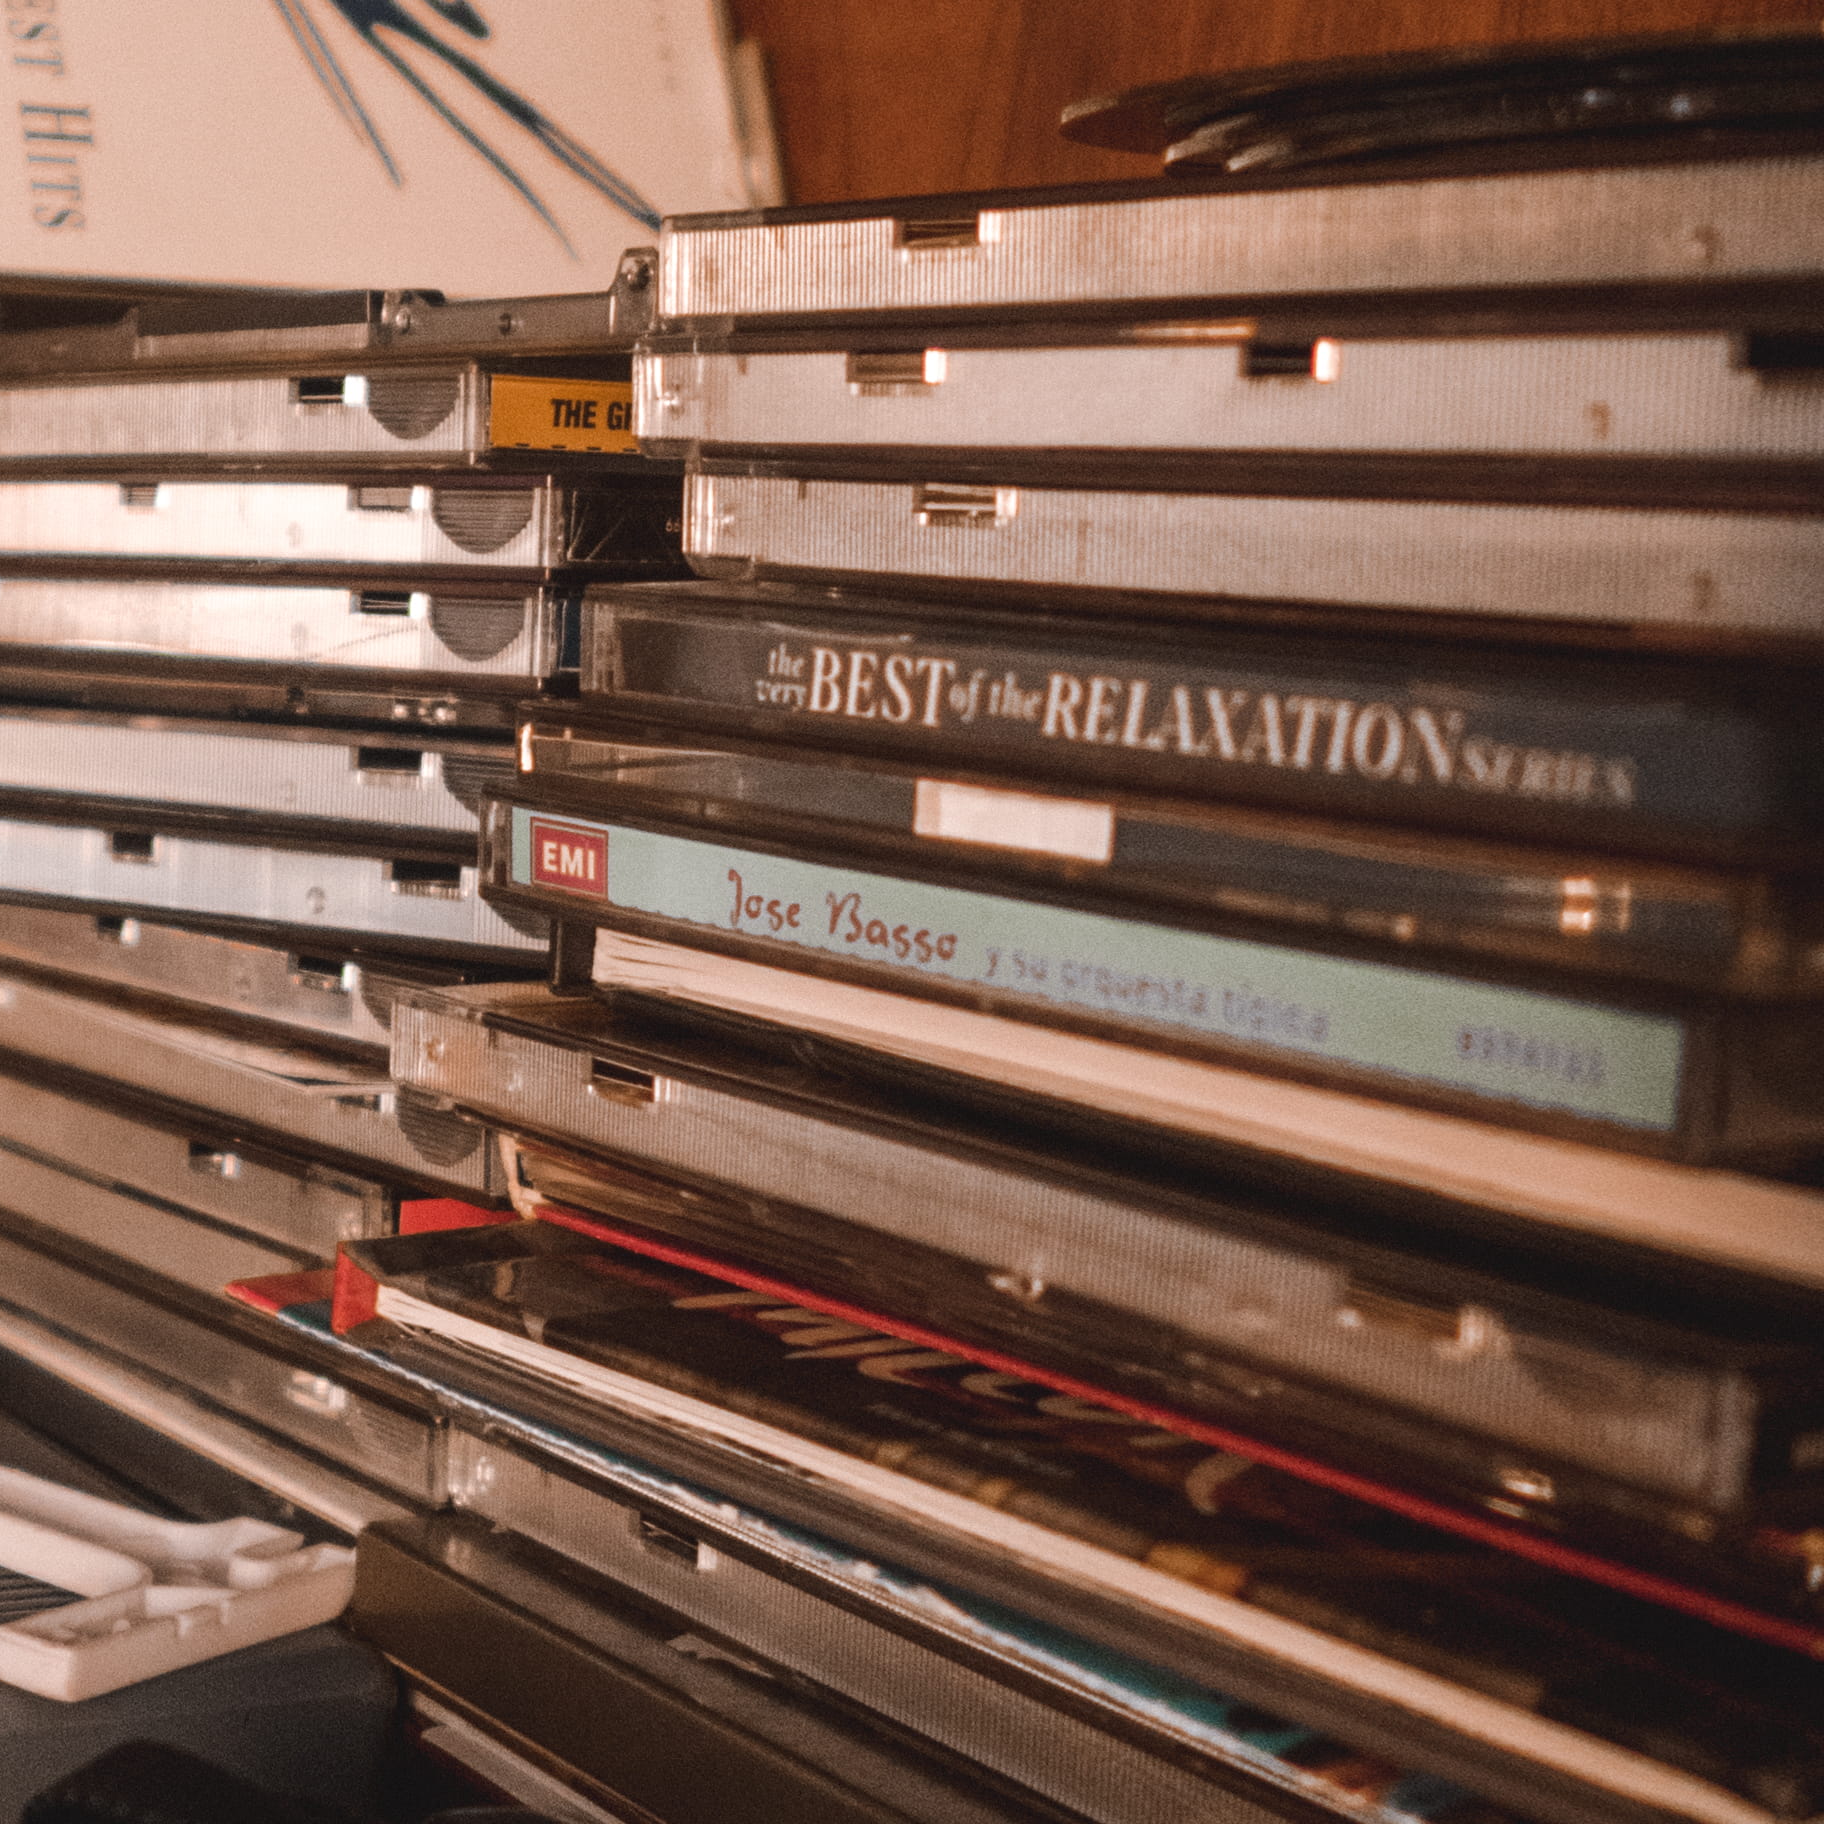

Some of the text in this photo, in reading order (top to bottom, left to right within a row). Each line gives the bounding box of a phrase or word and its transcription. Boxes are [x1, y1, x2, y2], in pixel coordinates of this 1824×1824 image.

[551, 399, 597, 429] THE
[768, 642, 805, 677] the
[809, 646, 956, 728] BEST
[947, 668, 985, 723] of
[987, 671, 1042, 720] the
[1040, 672, 1466, 785] RELAXATION
[542, 840, 596, 880] EMI
[727, 868, 802, 932] Jose
[825, 890, 958, 964] Basso
